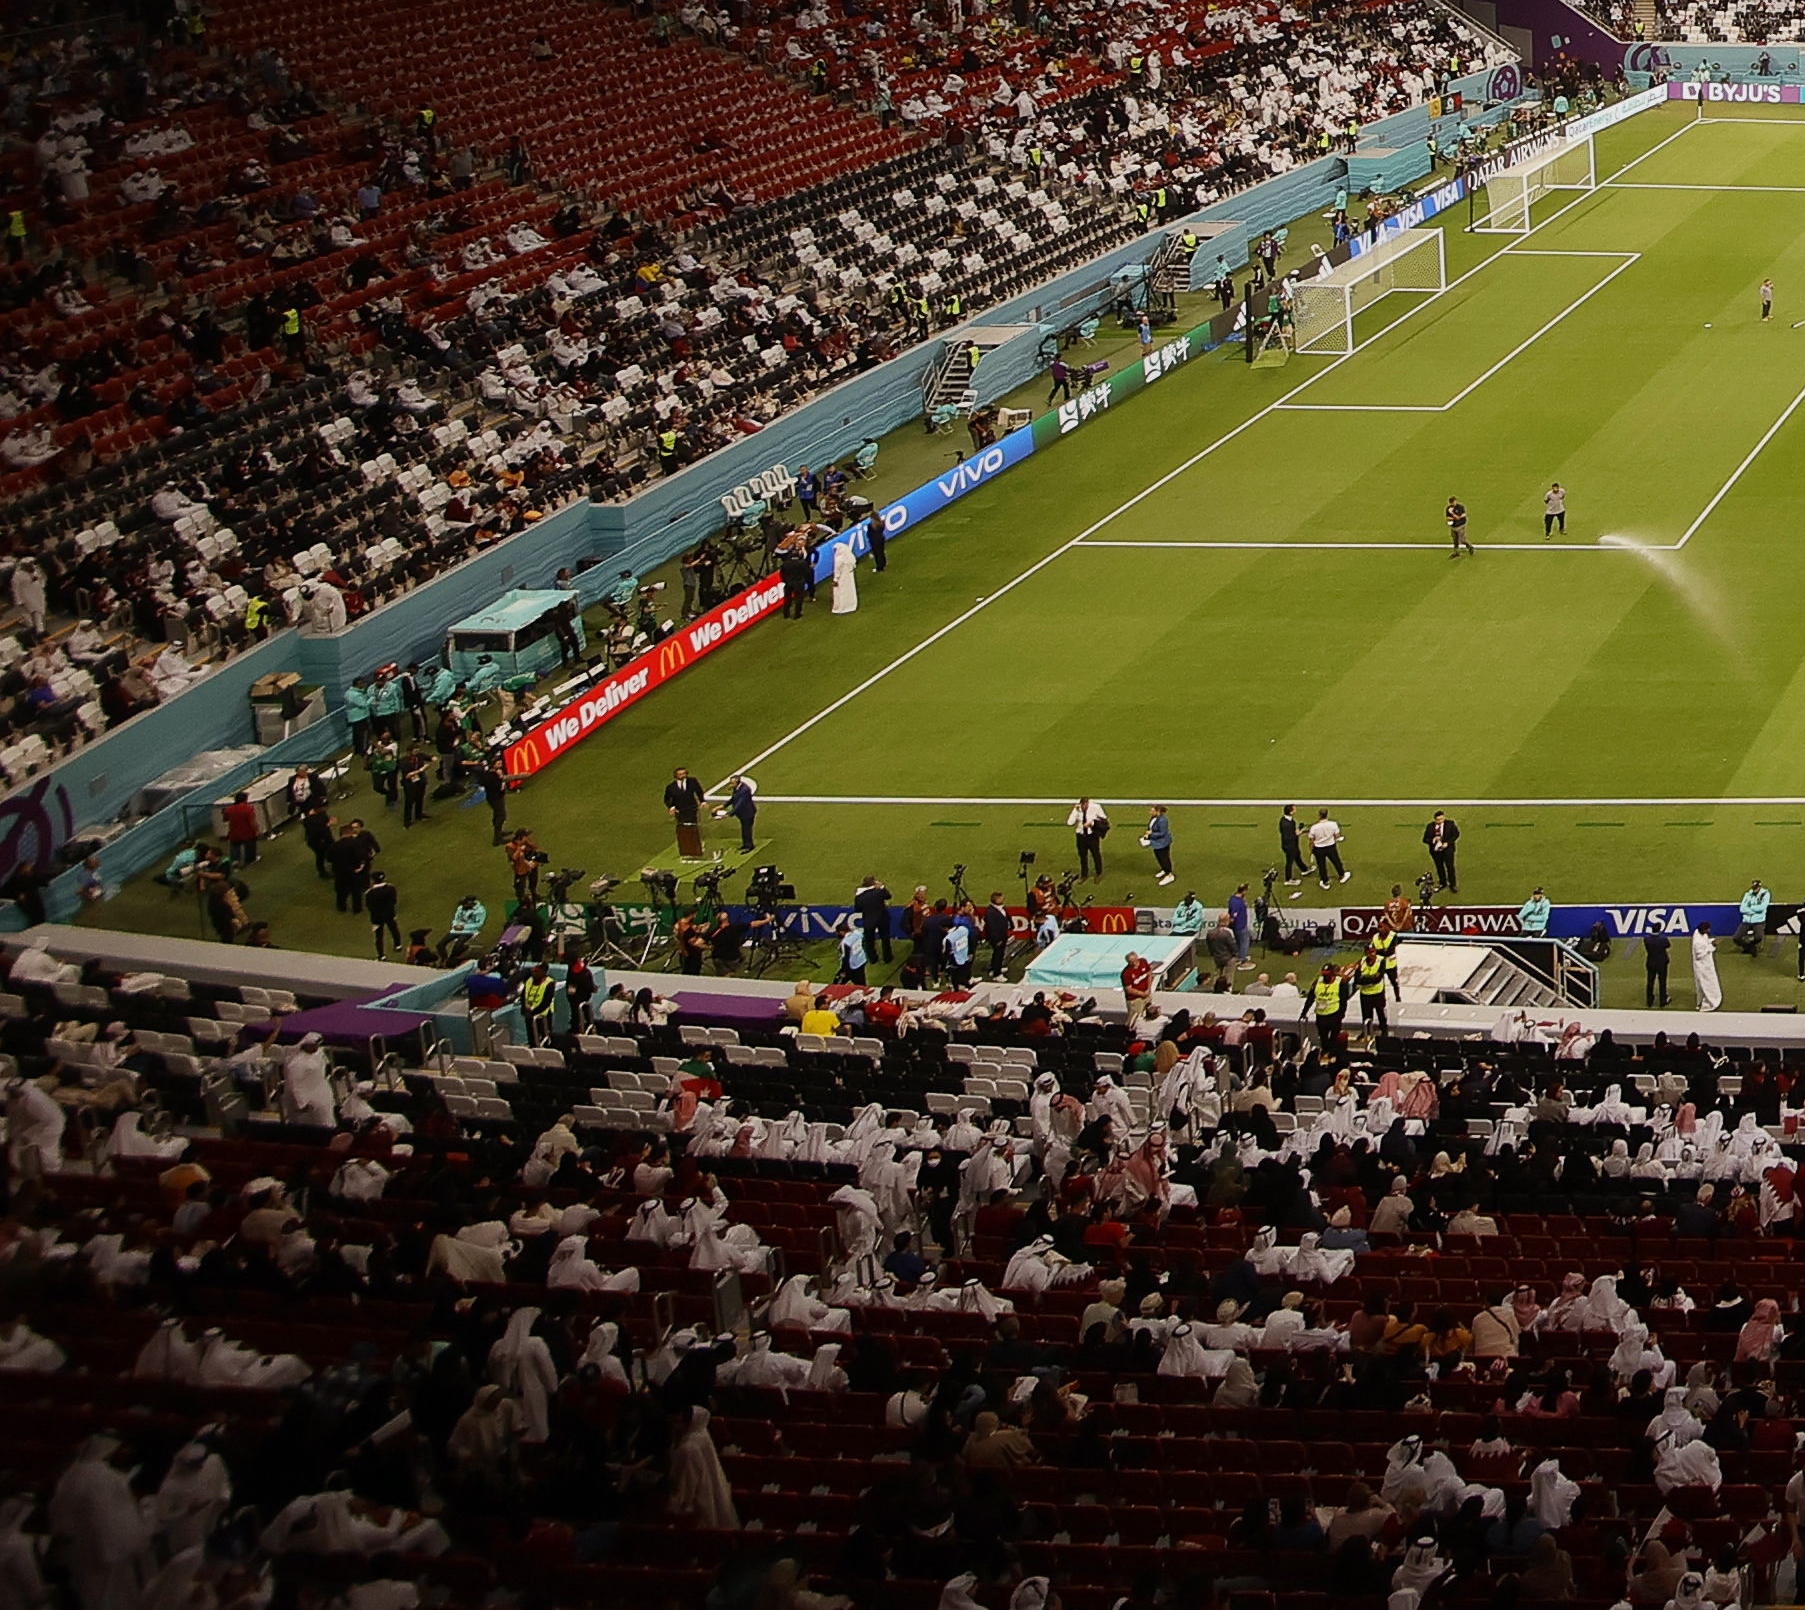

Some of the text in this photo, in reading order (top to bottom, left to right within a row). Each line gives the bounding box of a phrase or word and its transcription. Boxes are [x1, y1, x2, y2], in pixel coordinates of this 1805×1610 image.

[1708, 83, 1781, 103] BYJU'S
[1568, 108, 1613, 139] QatarEnergy
[1467, 159, 1505, 190] QATAR
[1433, 181, 1460, 210] VISA
[1397, 202, 1424, 232] VISA
[937, 448, 1003, 498] vivo
[689, 582, 786, 653] We Deliver
[545, 667, 649, 752] We Deliver
[1605, 908, 1690, 934] VISA
